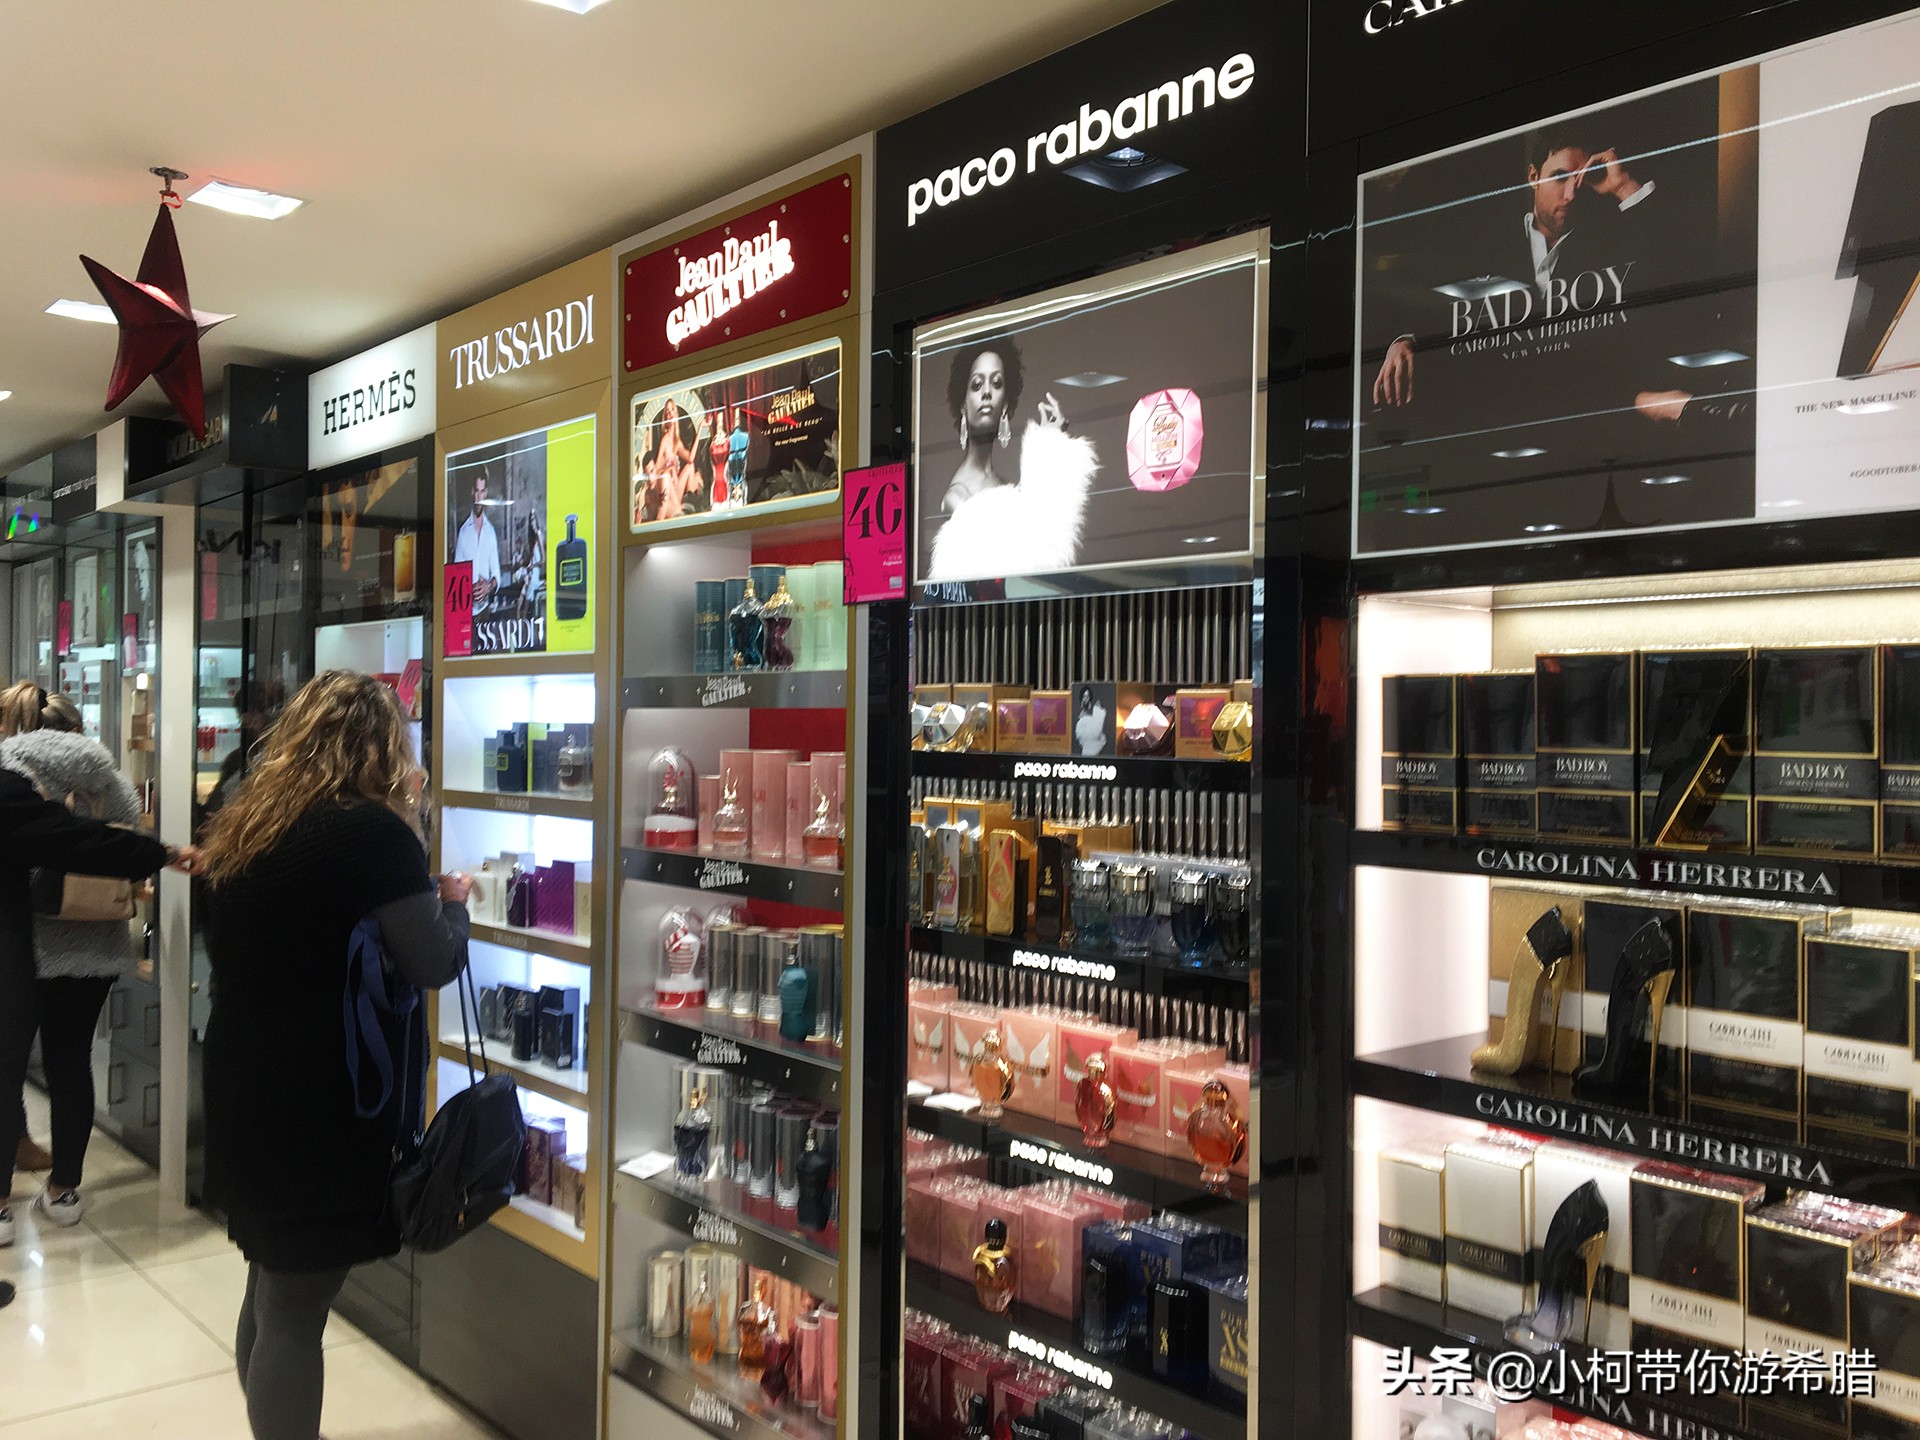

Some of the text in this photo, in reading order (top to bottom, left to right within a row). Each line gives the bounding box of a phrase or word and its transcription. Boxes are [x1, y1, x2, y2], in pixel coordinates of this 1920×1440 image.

[1363, 0, 1464, 34] CA
[907, 52, 1255, 227] paco rabanne
[674, 219, 778, 298] Jean Paul
[665, 237, 795, 345] GAULTIER
[1448, 261, 1637, 339] BAD BOY
[449, 294, 595, 390] TRUSSARDI
[1450, 308, 1629, 357] CAROLINA HERRERA
[1795, 403, 1818, 414] THE
[1850, 389, 1917, 406] MASCULINE
[476, 617, 535, 651] SSARDI
[1014, 760, 1117, 781] paco rabanne
[1477, 847, 1839, 897] CAROLINA HERRERA
[1051, 954, 1117, 982] rabanne
[1475, 1092, 1835, 1187] CAROLINA HERRERA
